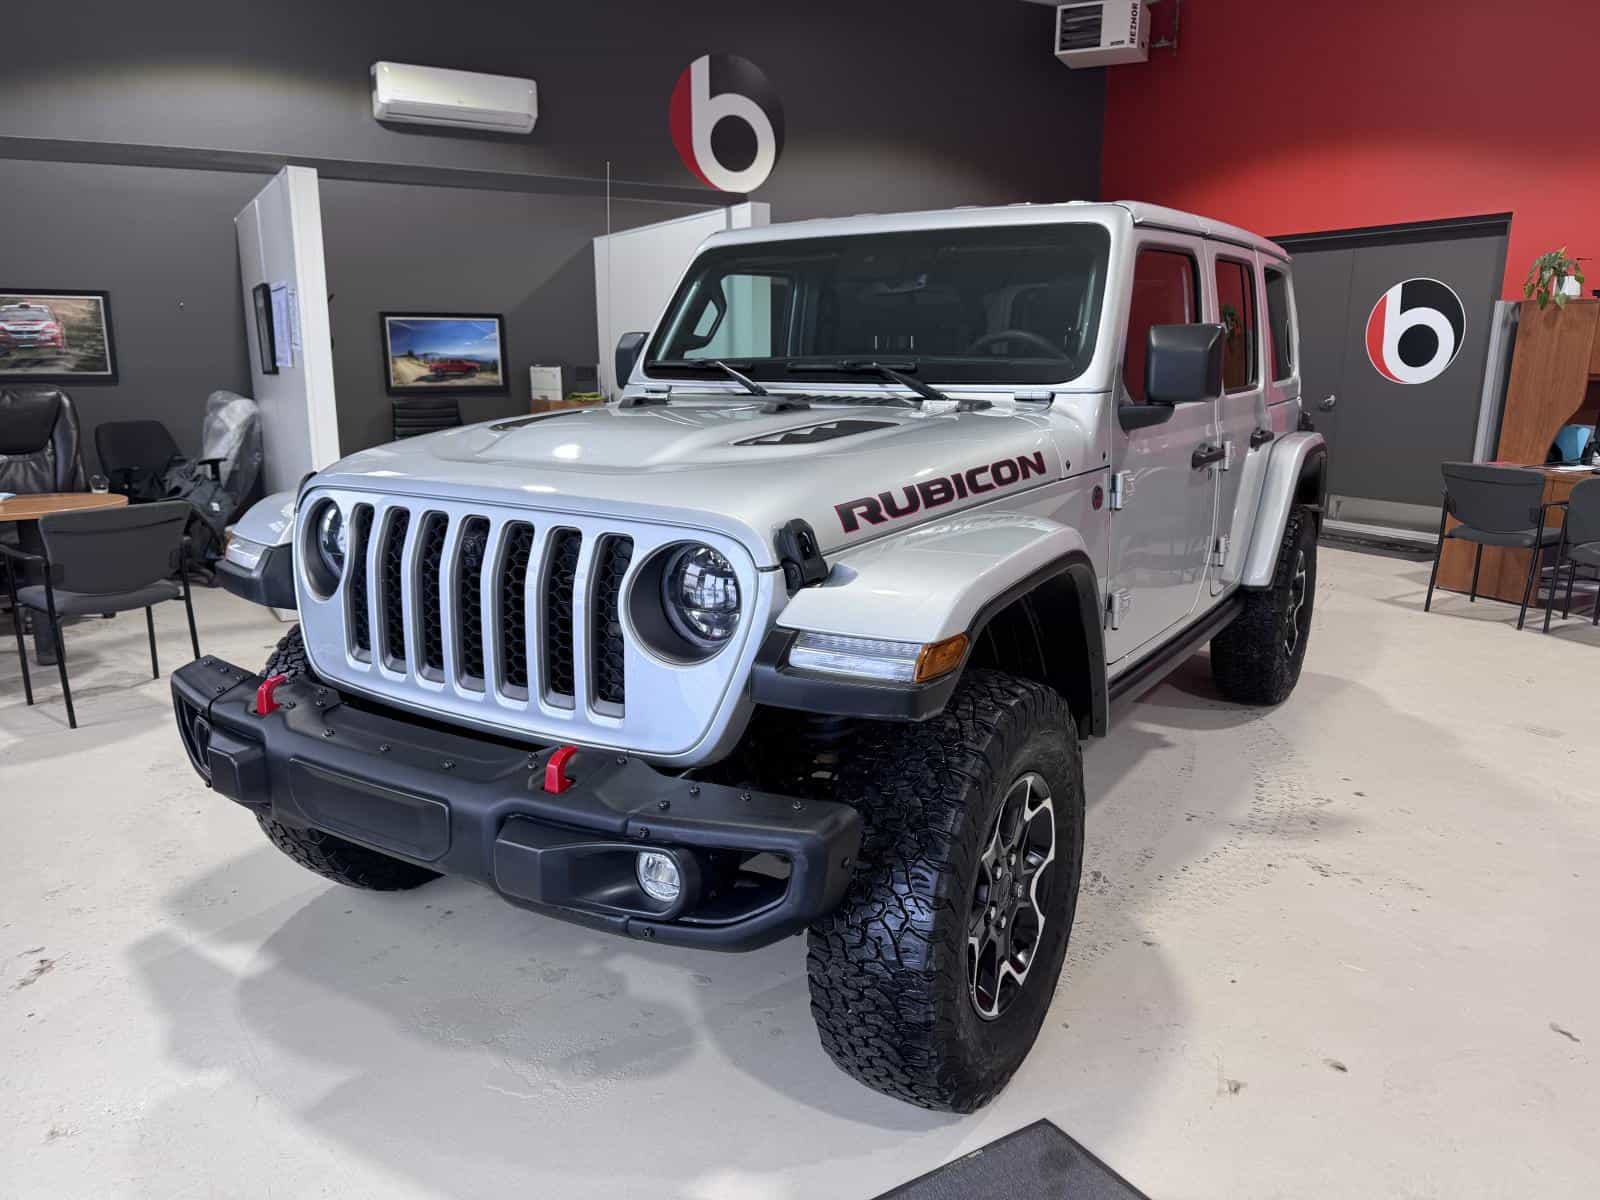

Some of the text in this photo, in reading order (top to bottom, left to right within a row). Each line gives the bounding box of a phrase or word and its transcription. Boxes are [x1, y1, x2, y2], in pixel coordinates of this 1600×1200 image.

[1129, 3, 1139, 44] REZNOR
[690, 54, 776, 194] b
[1382, 282, 1455, 384] b
[834, 451, 1047, 533] RUBICON
